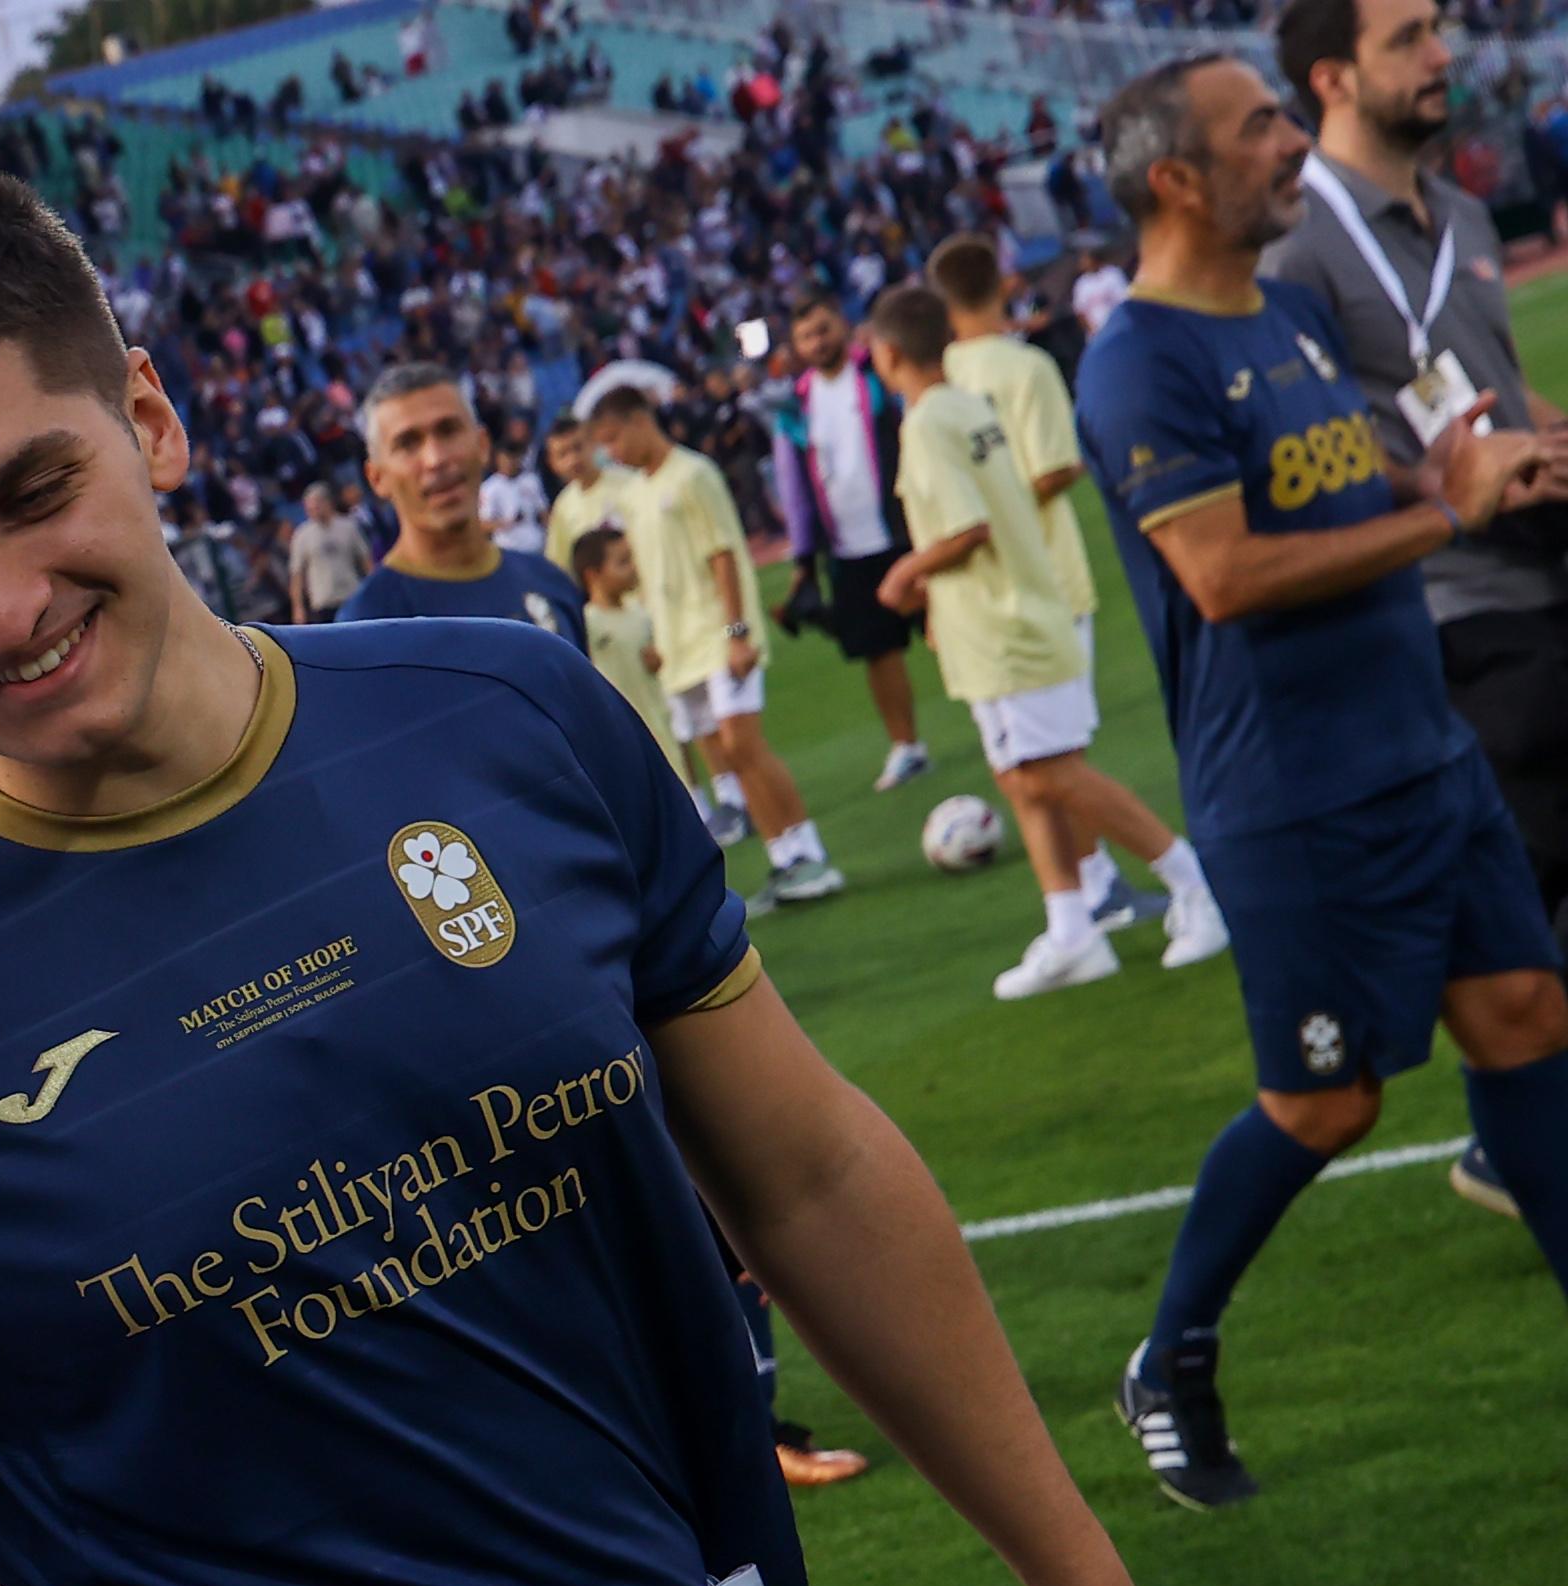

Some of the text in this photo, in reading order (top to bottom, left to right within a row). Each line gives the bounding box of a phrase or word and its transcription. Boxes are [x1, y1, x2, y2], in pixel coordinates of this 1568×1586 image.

[439, 900, 504, 956] SPF
[178, 936, 358, 1034] MATCH OF HOPE
[234, 1012, 284, 1041] SEPTEMBER
[314, 979, 355, 1002] BULGARIA
[216, 1020, 236, 1033] The
[75, 1044, 645, 1338] The Stiliyan Petrov
[231, 1166, 588, 1367] Foundation
